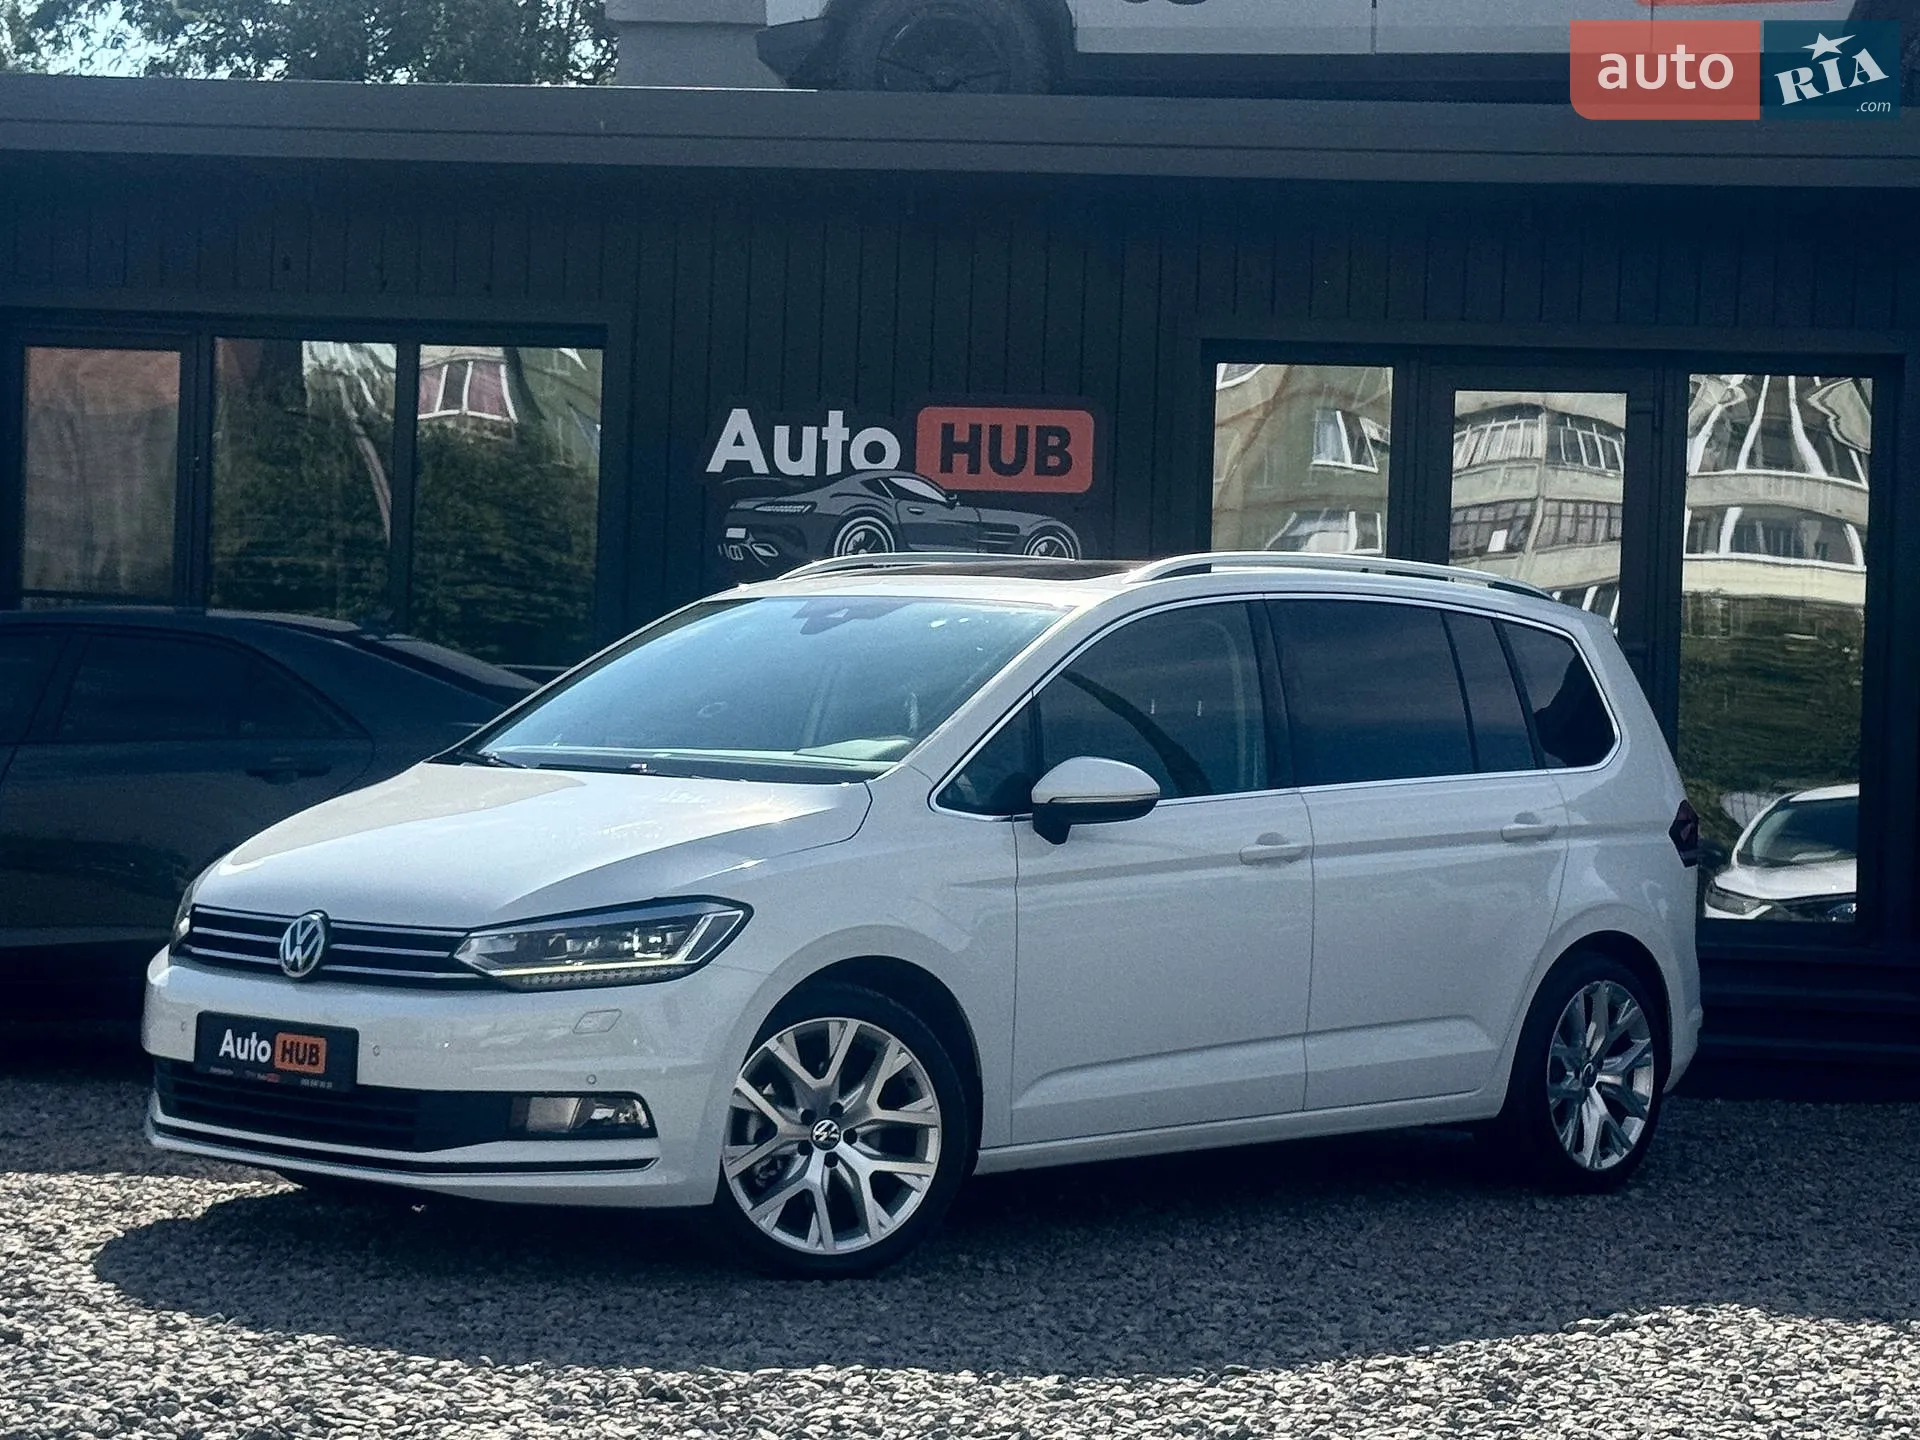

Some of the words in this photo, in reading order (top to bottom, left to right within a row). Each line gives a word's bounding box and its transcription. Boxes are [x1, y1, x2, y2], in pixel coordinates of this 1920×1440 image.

[706, 408, 901, 477] Auto
[940, 422, 1073, 477] HUB
[218, 1028, 272, 1063] Auto
[281, 1039, 320, 1066] HUB
